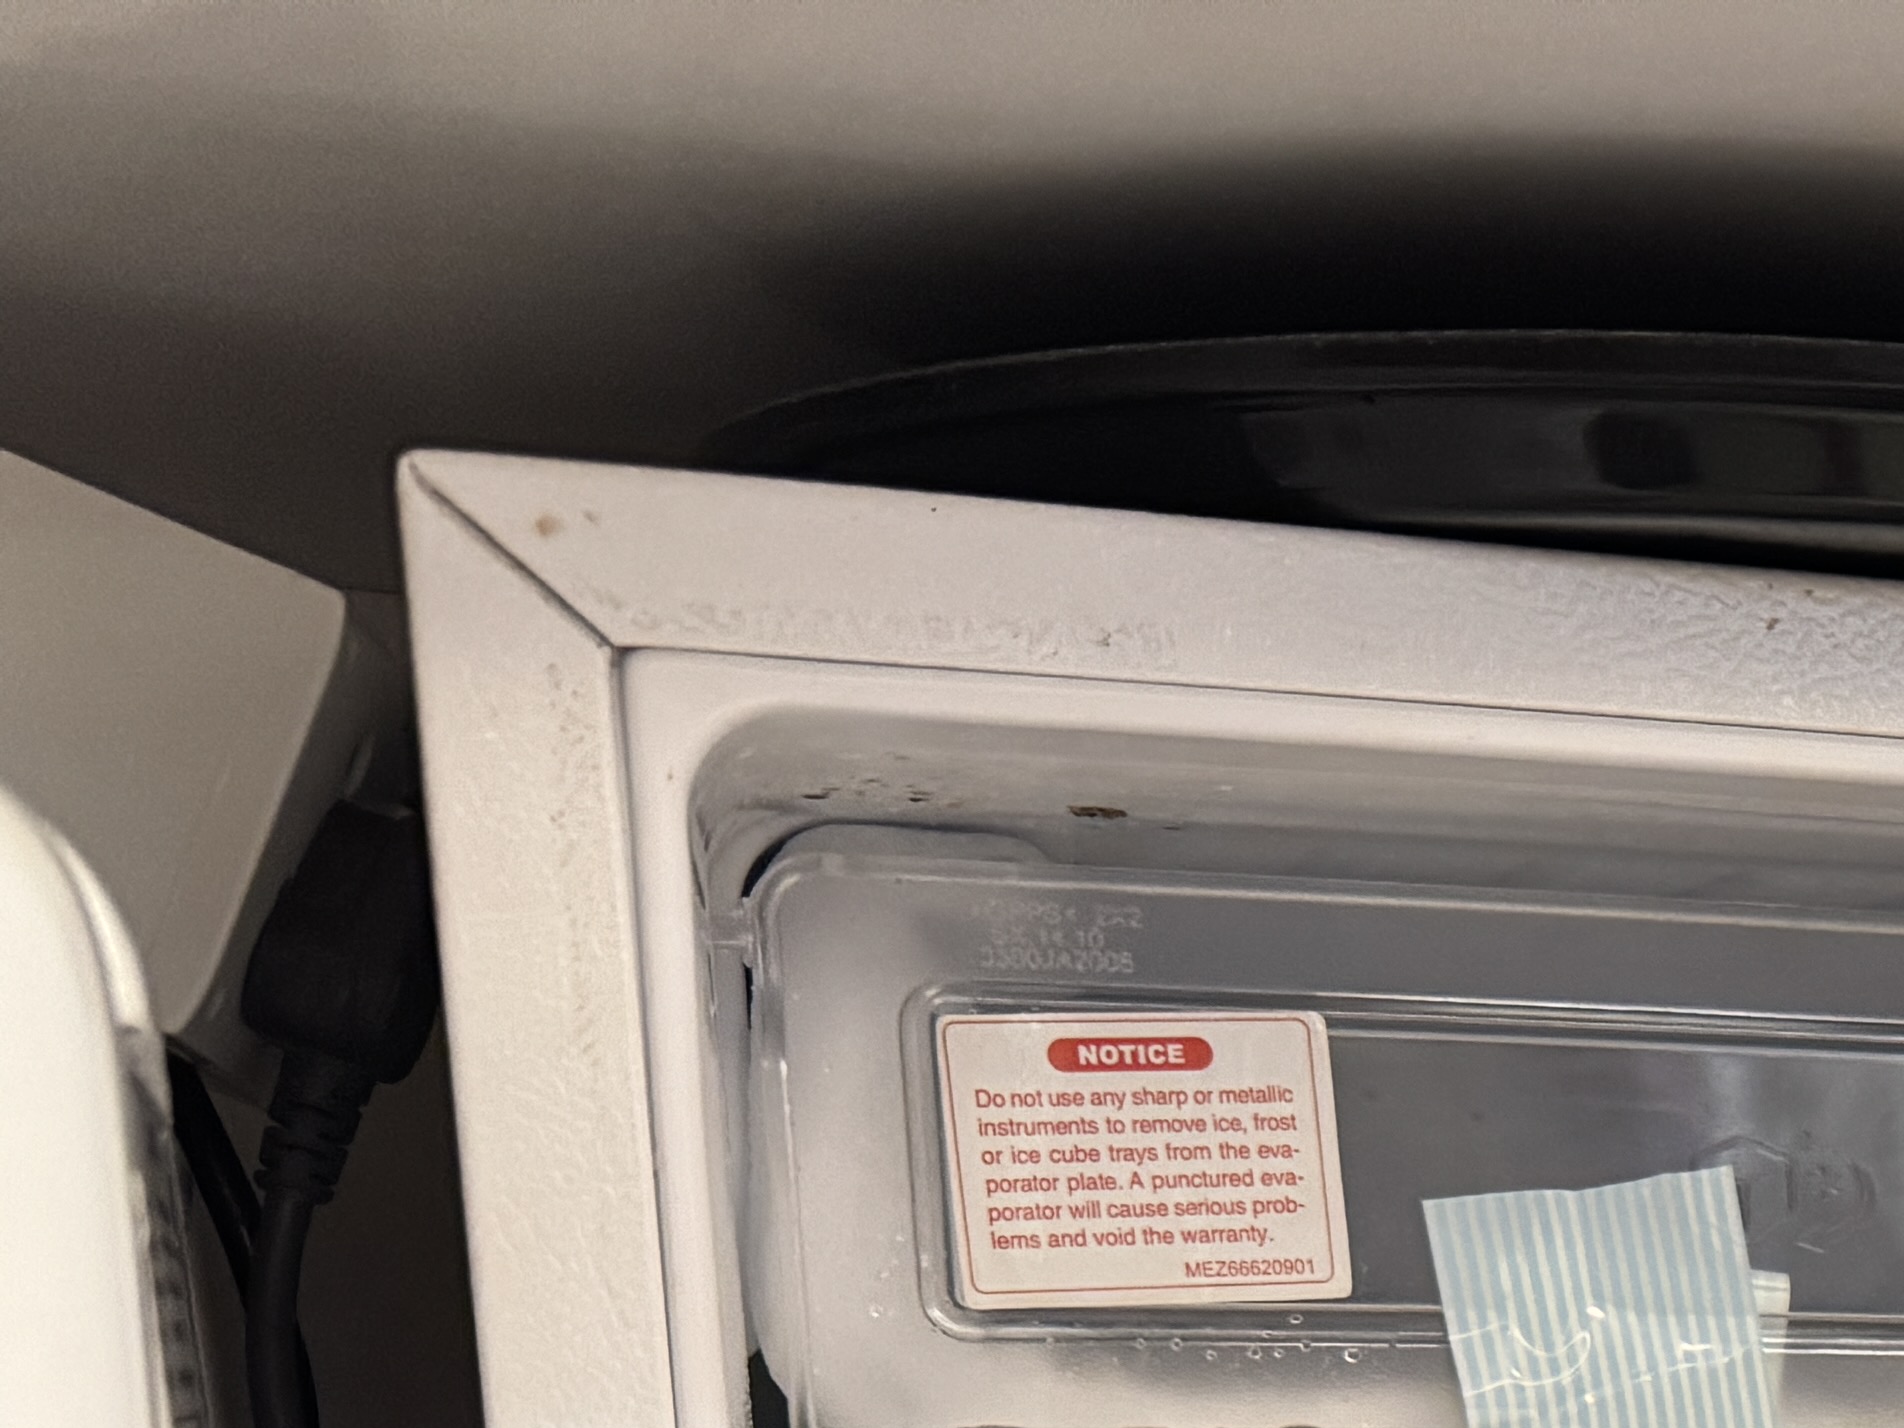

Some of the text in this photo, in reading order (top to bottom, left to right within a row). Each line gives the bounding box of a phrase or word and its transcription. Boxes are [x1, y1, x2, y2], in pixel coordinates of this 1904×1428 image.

[1077, 1044, 1186, 1066] NOTICE
[975, 1085, 1294, 1110] Do not use any sharp or metallic
[978, 1112, 1297, 1137] instruments to remove ice, frost
[981, 1142, 1299, 1166] or ice cube trays from the eva-
[986, 1169, 1304, 1197] porator plate. A punctured eva-
[988, 1196, 1305, 1225] porator will cause serious prob-
[991, 1225, 1274, 1249] lems and void the warranty.
[1184, 1260, 1315, 1278] MEZ66620901
